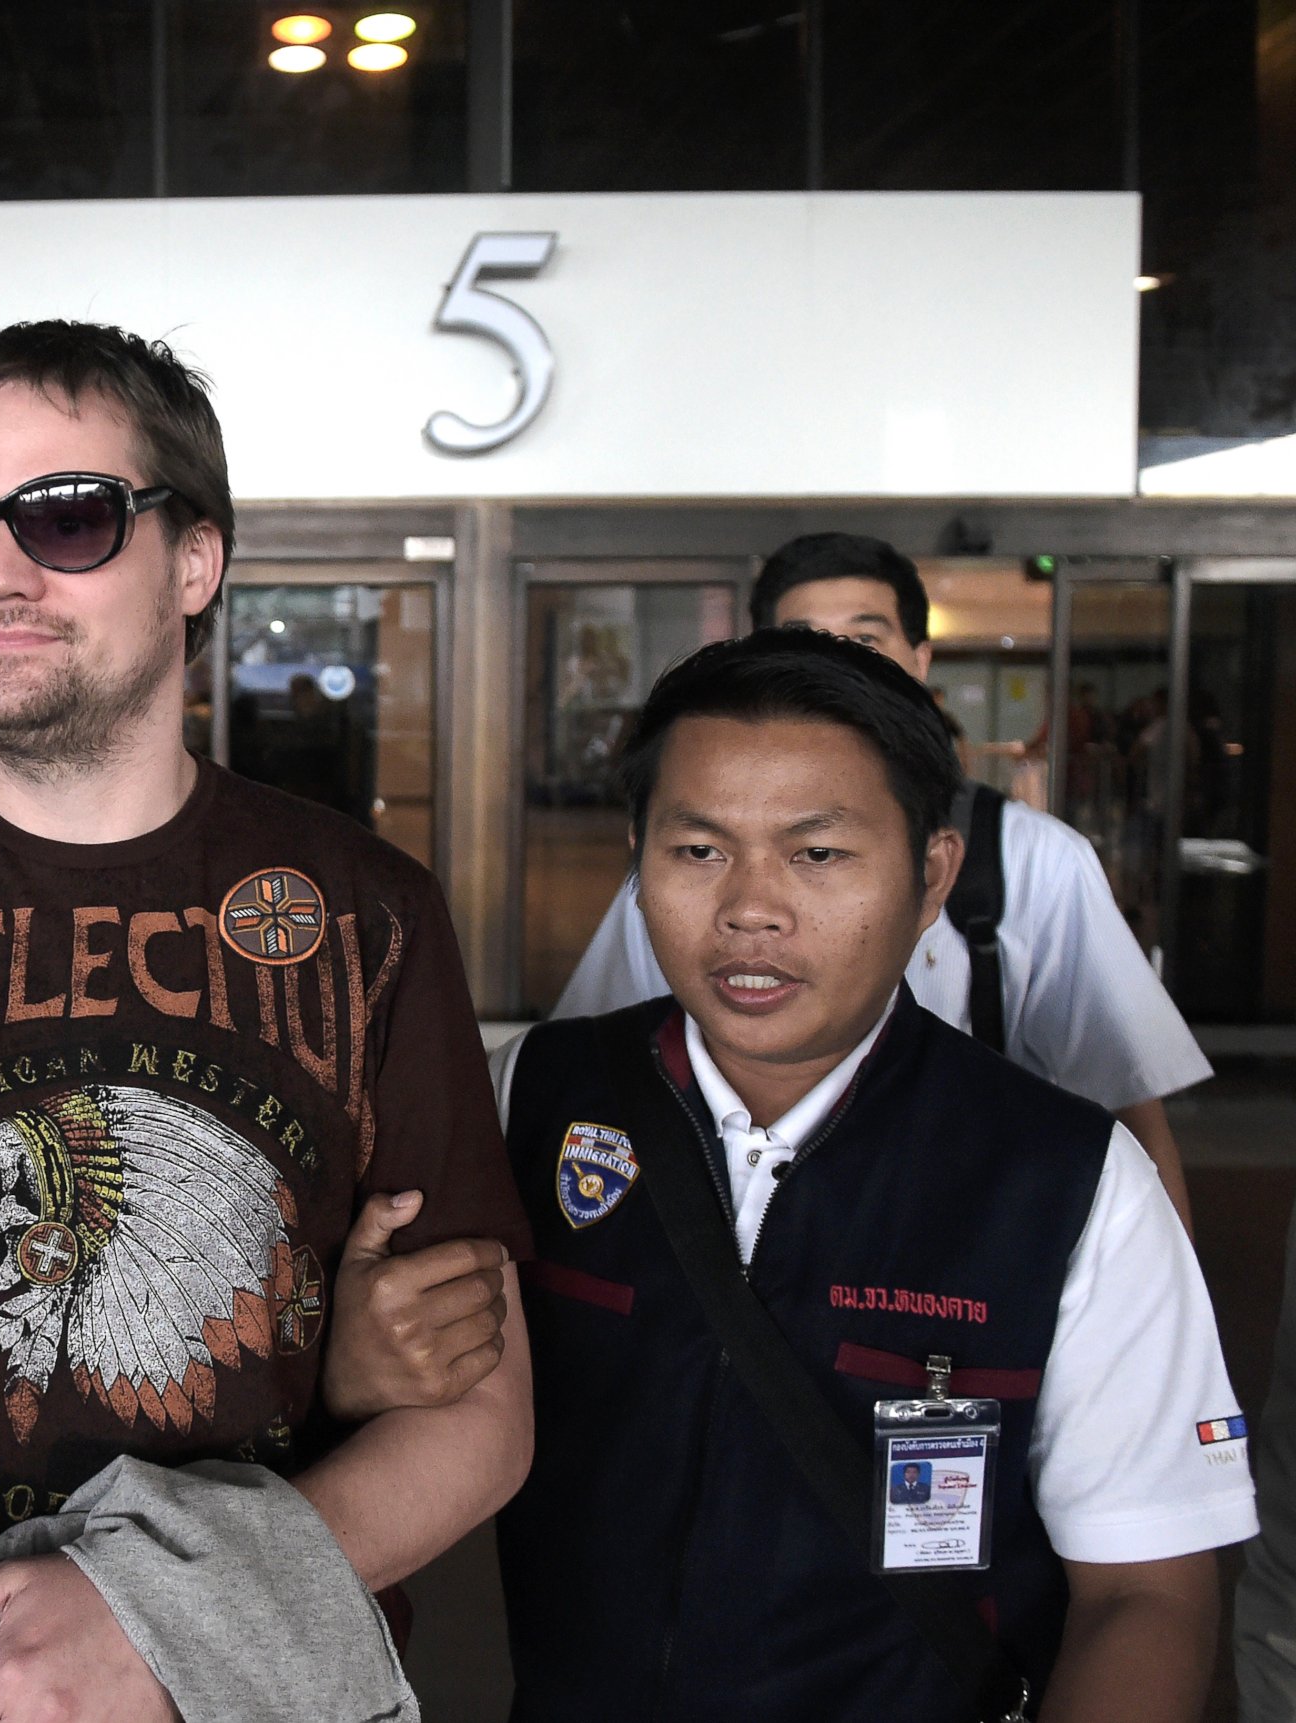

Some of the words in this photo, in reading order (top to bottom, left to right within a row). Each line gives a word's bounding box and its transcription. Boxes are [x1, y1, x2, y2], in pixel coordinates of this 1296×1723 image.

[420, 231, 560, 460] 5
[127, 1043, 318, 1170] WESTERN
[572, 1126, 598, 1138] ROYAL
[599, 1129, 620, 1143] THAI
[564, 1145, 638, 1179] IMMIGRATION
